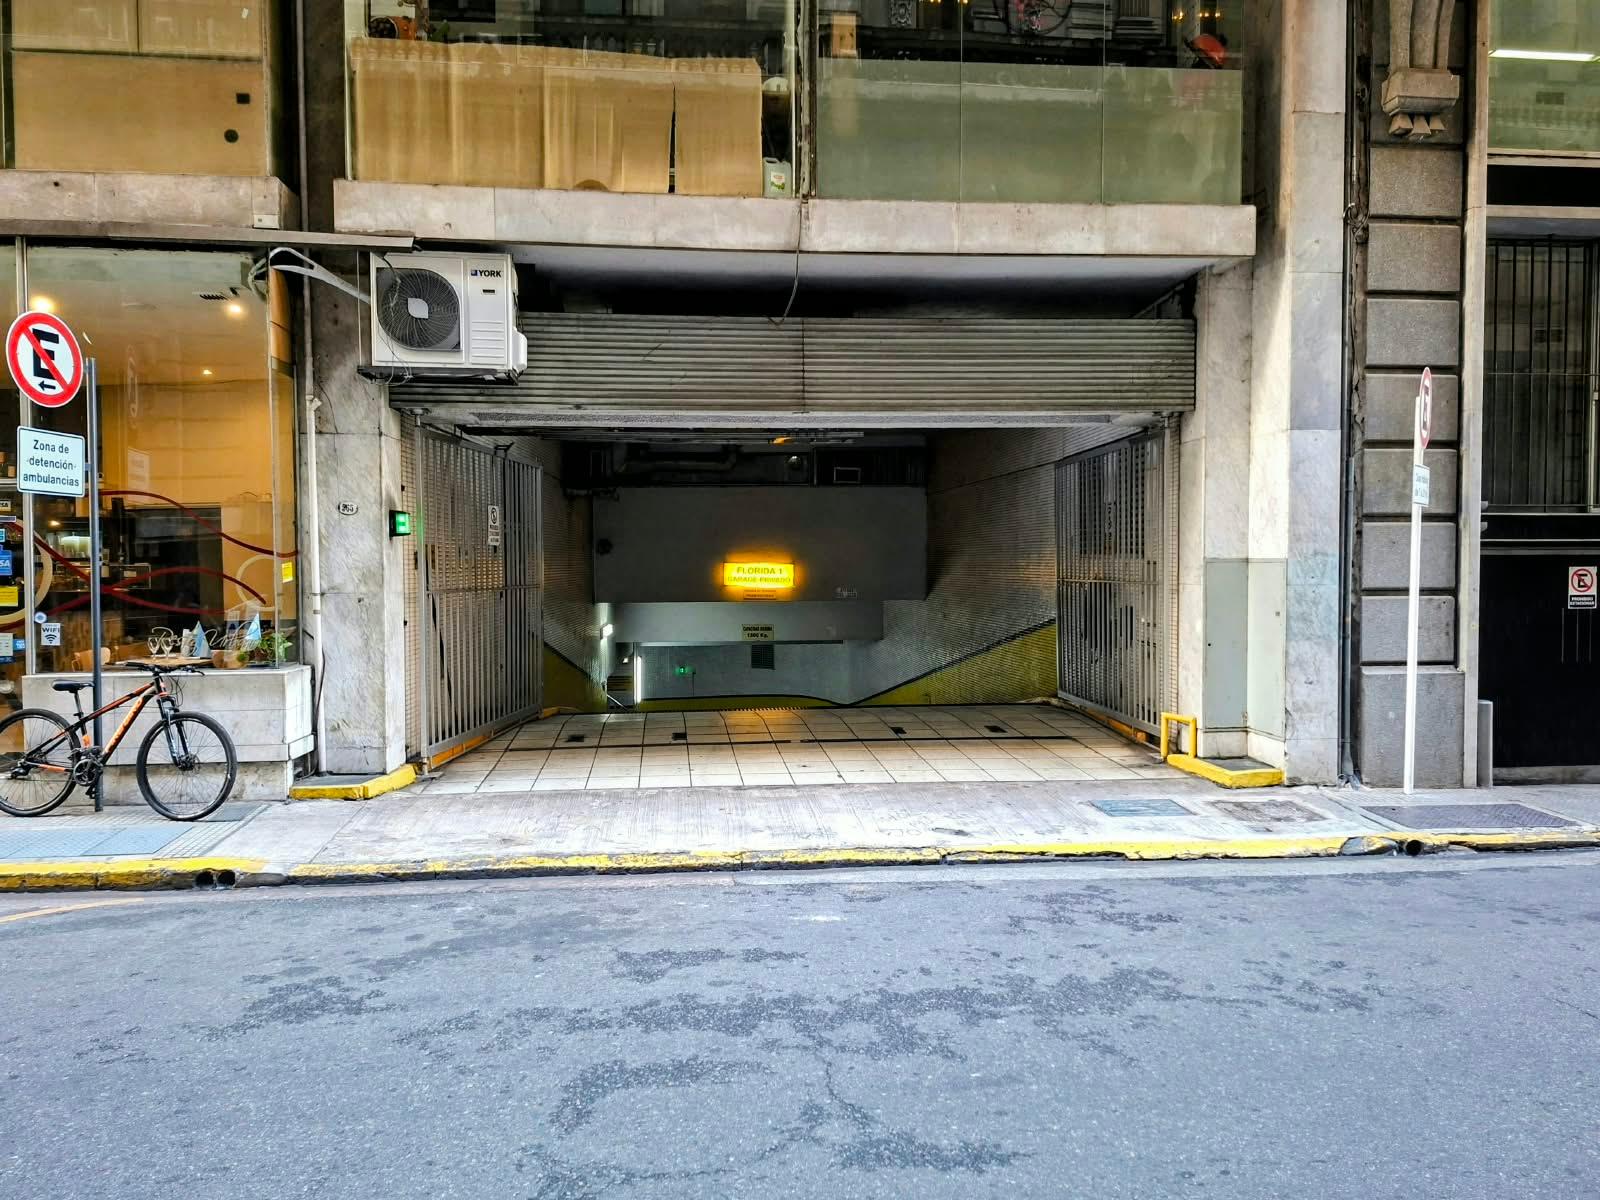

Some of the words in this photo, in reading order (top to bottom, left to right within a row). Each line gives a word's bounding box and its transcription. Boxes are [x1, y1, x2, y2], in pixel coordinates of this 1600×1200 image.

[478, 269, 502, 278] YORK
[33, 439, 56, 452] Zona
[58, 443, 70, 454] de
[28, 456, 74, 470] detención
[23, 473, 80, 487] ambulancias
[0, 559, 10, 567] SA
[736, 566, 776, 575] FLORIDA
